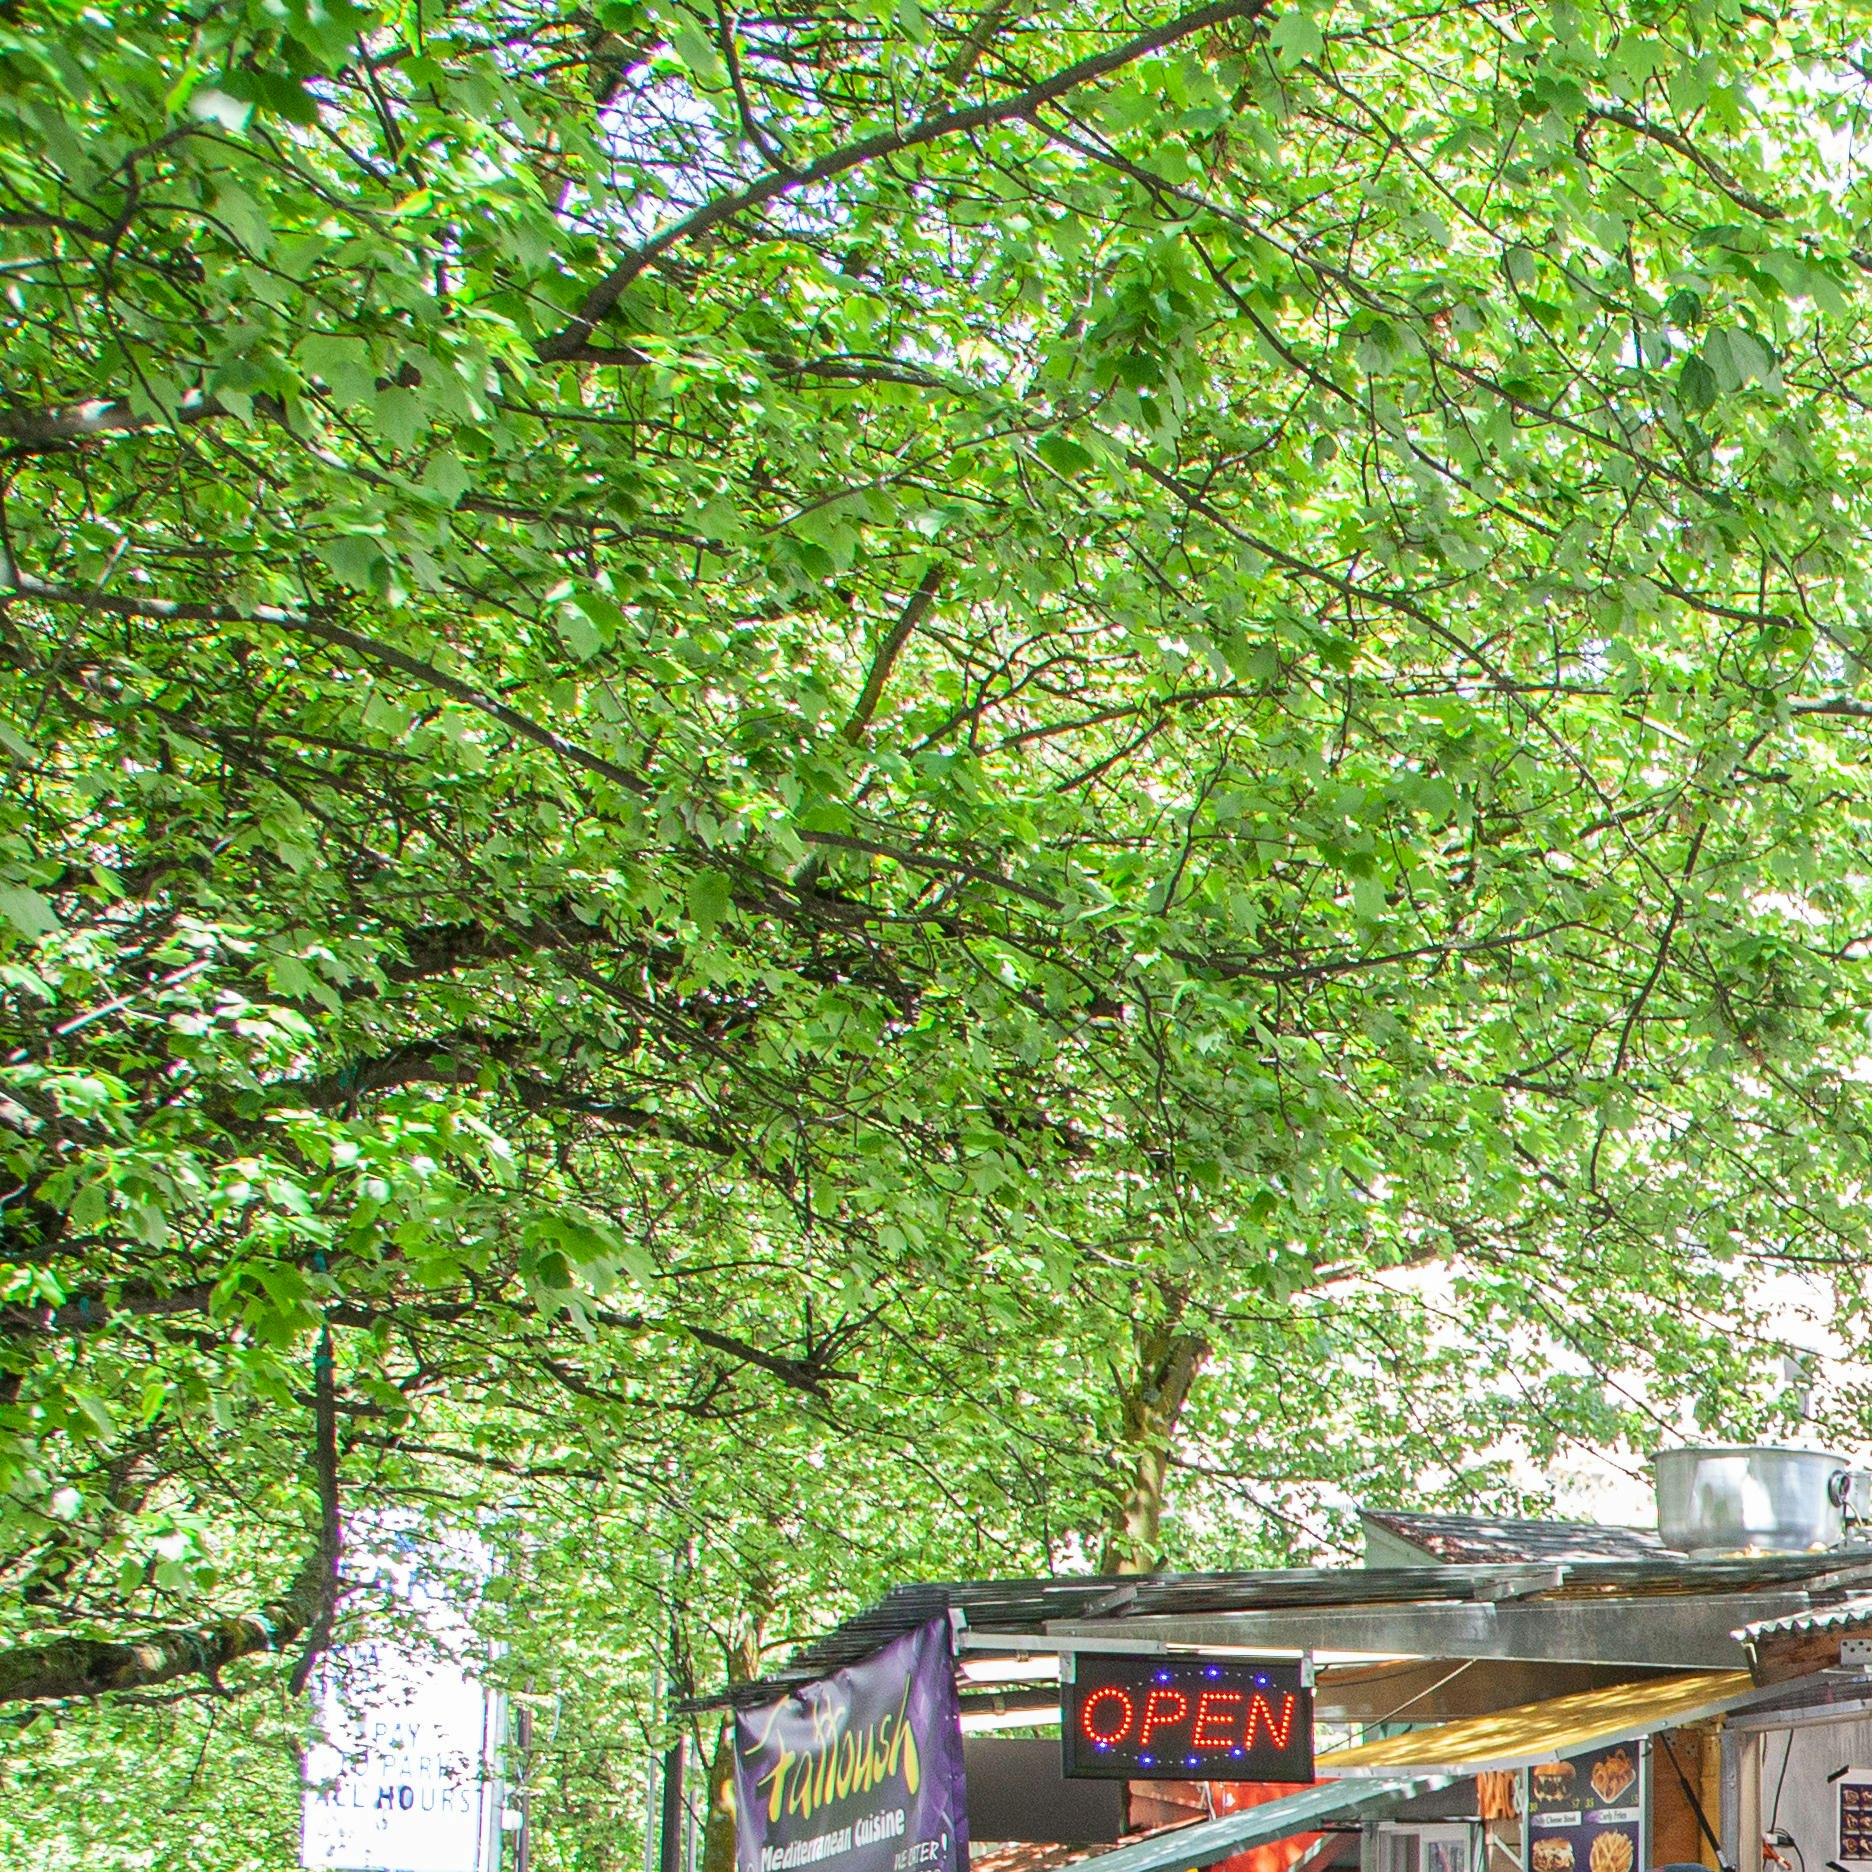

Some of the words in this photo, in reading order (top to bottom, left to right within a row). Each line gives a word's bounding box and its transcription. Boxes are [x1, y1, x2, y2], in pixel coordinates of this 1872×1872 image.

[1083, 1686, 1296, 1750] OPEN
[761, 1826, 852, 1872] Mediterranean
[854, 1808, 905, 1848] Cuisine
